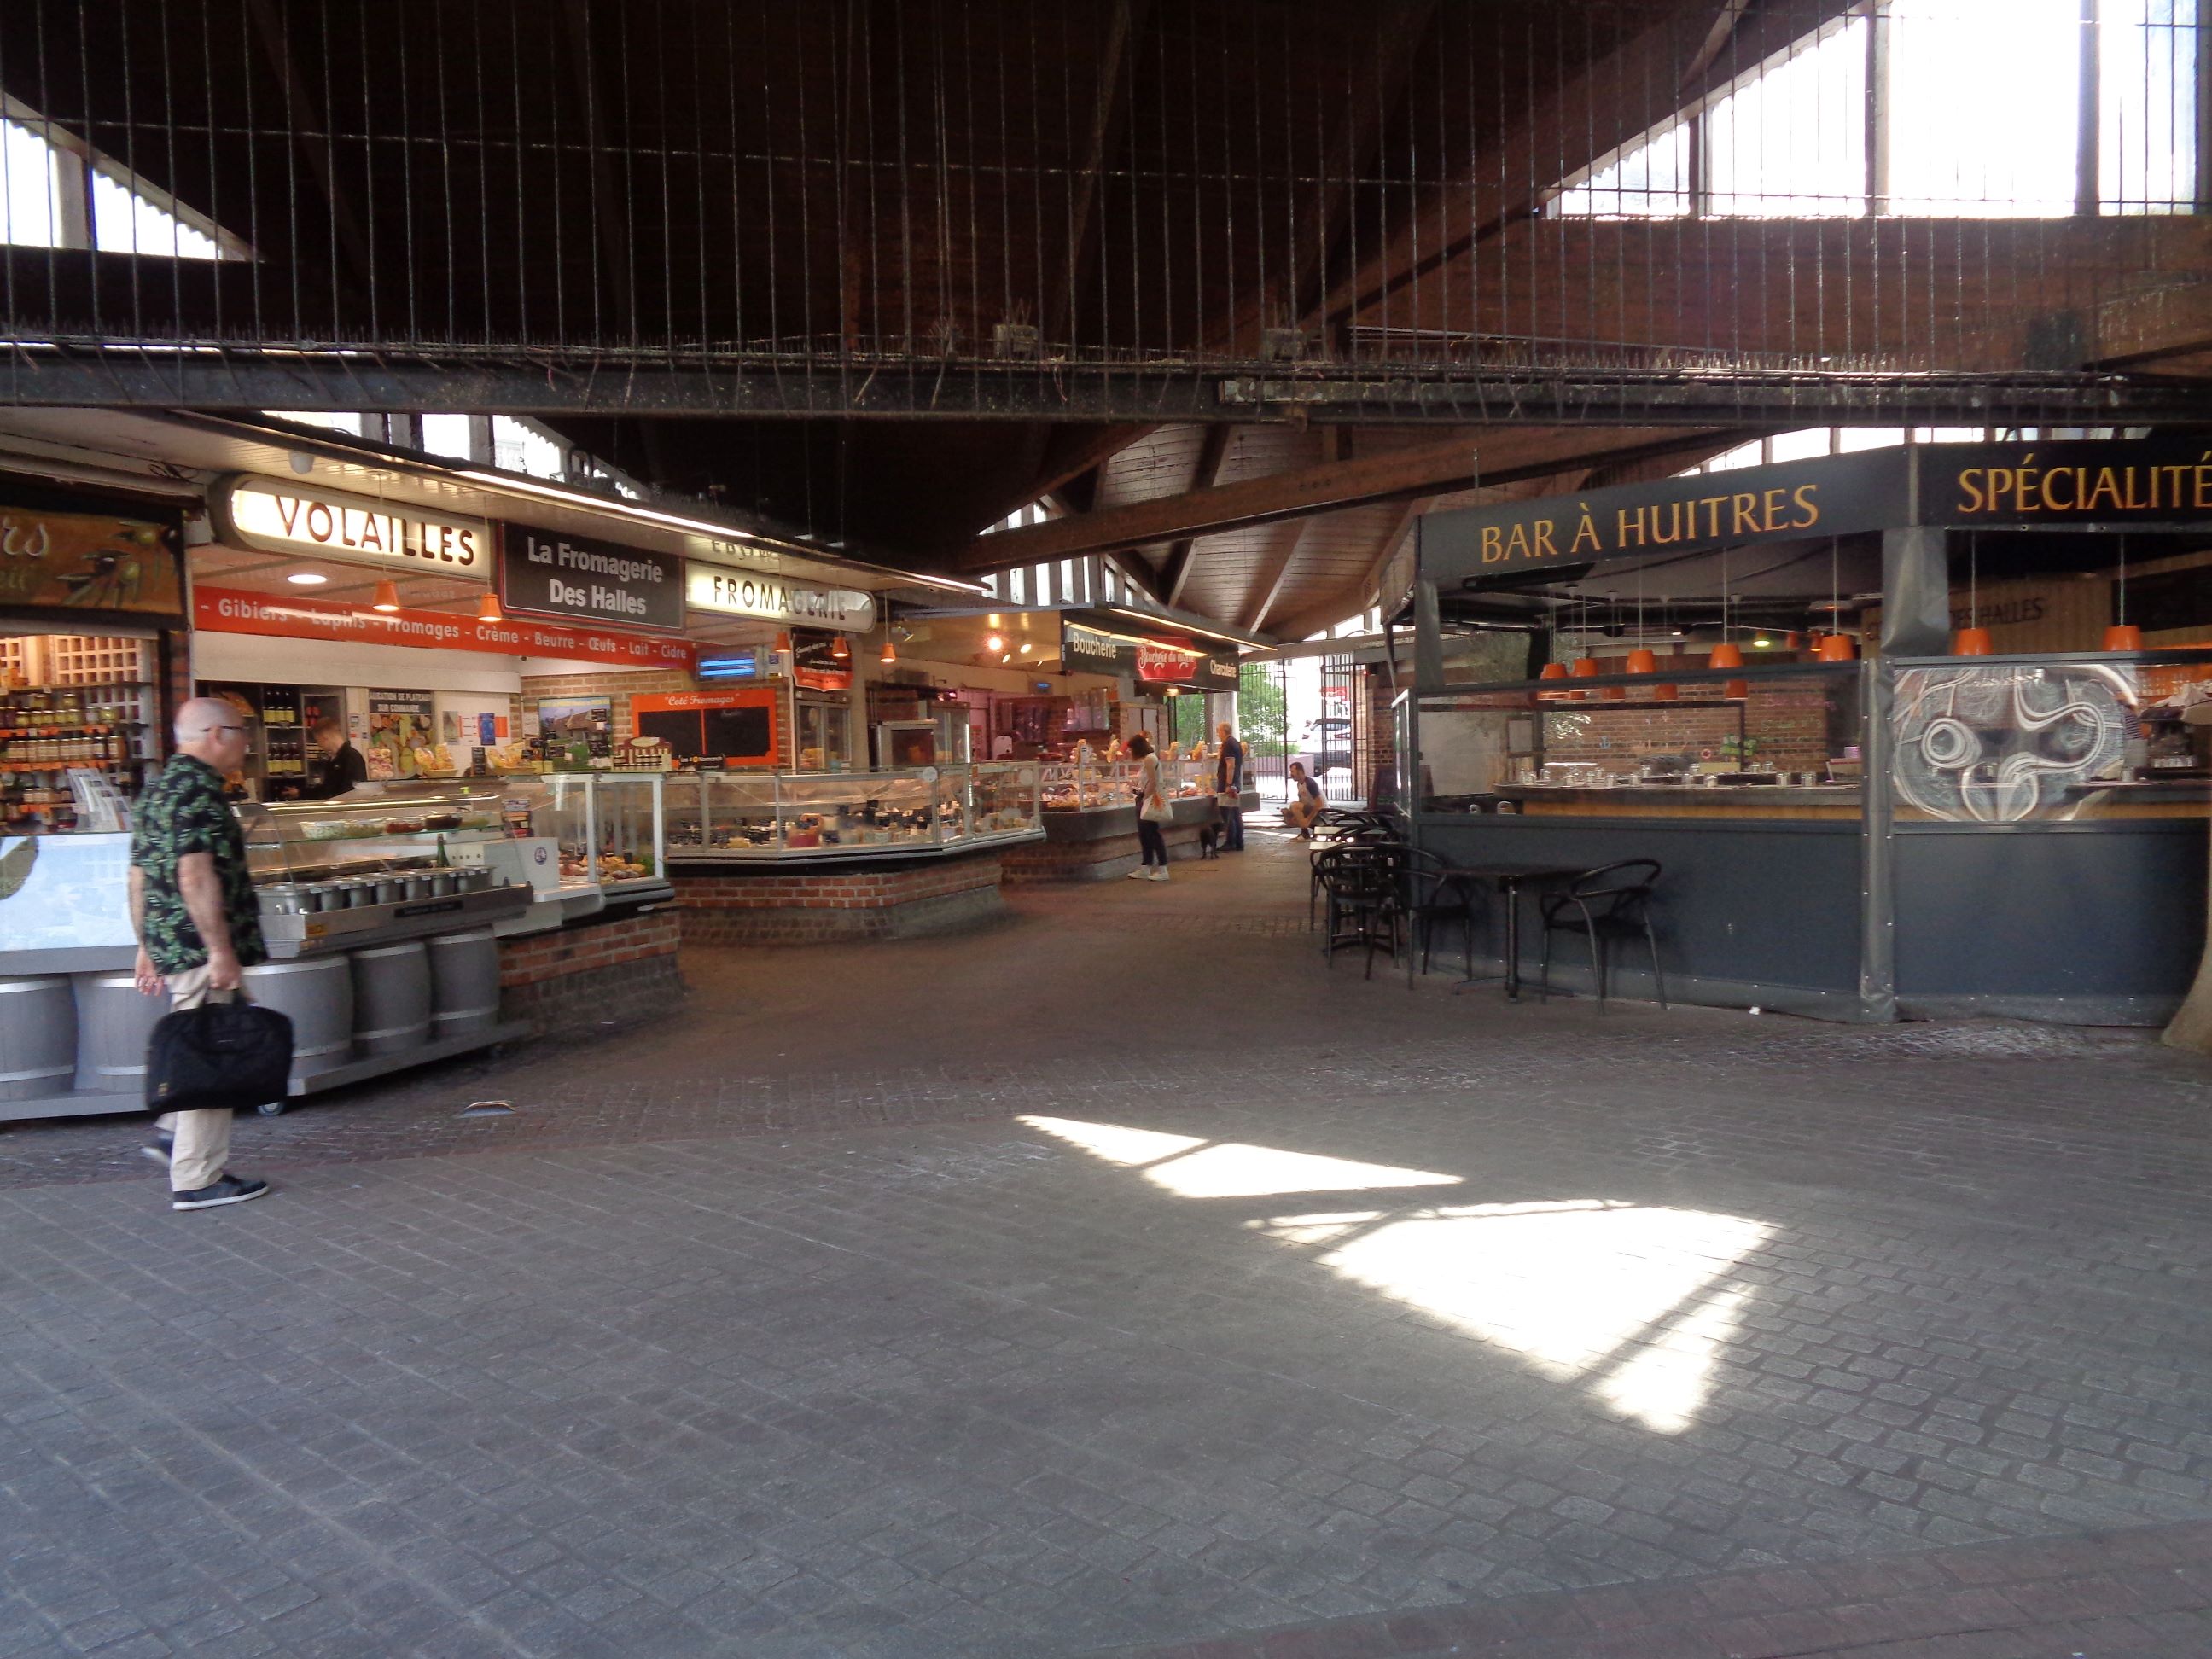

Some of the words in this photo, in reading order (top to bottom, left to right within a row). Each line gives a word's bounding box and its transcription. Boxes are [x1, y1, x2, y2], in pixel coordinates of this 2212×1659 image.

[275, 495, 475, 566] VOLAILLES
[1481, 518, 1558, 563] BAR
[1570, 502, 1602, 553] À
[1617, 484, 1819, 548] HUITRES
[527, 536, 553, 564] La
[557, 542, 663, 583] Fromagerie
[549, 578, 586, 607] Des
[591, 584, 647, 615] Halles
[713, 575, 846, 620] FROMAGERIE
[218, 597, 288, 623] Gibiers
[387, 614, 459, 641] Fromages
[475, 625, 519, 643] Crème
[534, 632, 574, 649] Beurre
[588, 637, 616, 653] Œufs
[628, 642, 649, 656] Lait
[661, 644, 687, 659] Cidre
[1073, 632, 1117, 659] Boucherie
